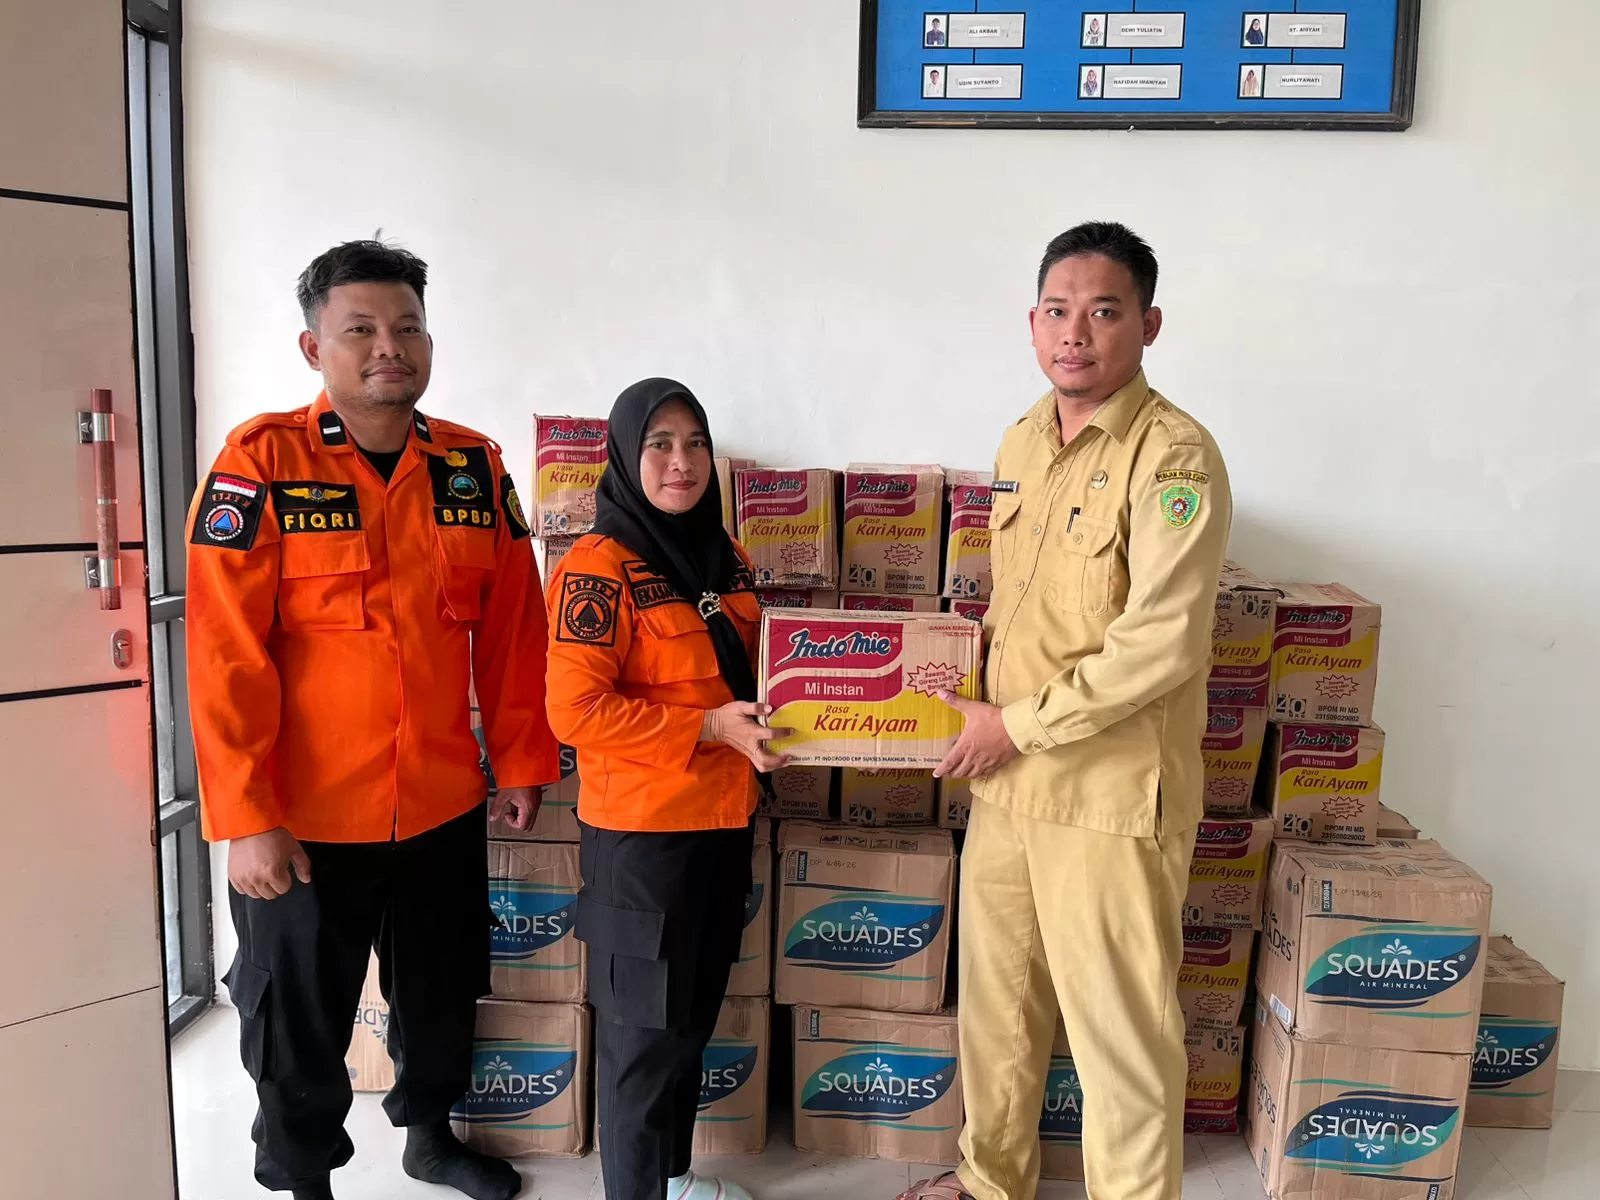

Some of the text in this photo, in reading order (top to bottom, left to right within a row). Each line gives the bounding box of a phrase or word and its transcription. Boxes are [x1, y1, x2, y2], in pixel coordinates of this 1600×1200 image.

[550, 471, 600, 488] Kari Ay
[284, 513, 354, 530] FIQRI
[442, 509, 492, 526] BPBD
[750, 523, 820, 539] Kari Ayam
[856, 523, 926, 540] Kari Ayam
[961, 536, 992, 548] Kari
[1293, 635, 1328, 644] Mi Instan
[1285, 654, 1362, 671] Kari Ayam
[918, 677, 938, 687] Goreng
[924, 670, 946, 679] Bawang
[804, 682, 864, 696] Mi Instan
[825, 704, 849, 714] Rasa
[1317, 705, 1339, 713] BPOM
[813, 713, 918, 737] Kari Ayam
[1212, 759, 1253, 772] Ayam
[1301, 757, 1336, 766] Mi Instan
[1293, 775, 1369, 793] Kari Ayam
[1324, 824, 1344, 832] BPOM
[1189, 865, 1256, 880] Kari Ayam
[489, 913, 563, 937] ADES
[492, 935, 535, 943] MINERAL
[801, 918, 925, 949] SQUADES
[831, 945, 895, 955] AIR MINERAL
[1326, 952, 1460, 982] SQUADES
[1179, 972, 1240, 988] ari Ayam
[1359, 981, 1429, 991] AIR MINERAL
[1474, 1046, 1539, 1067] ADES
[470, 1073, 558, 1096] UADES
[817, 1069, 938, 1099] SQUADES
[487, 1096, 530, 1104] MINERAL
[848, 1095, 910, 1105] AIR MINERAL
[1338, 1107, 1407, 1120] MINERAL AIR
[1308, 1113, 1439, 1147] SQUADES
